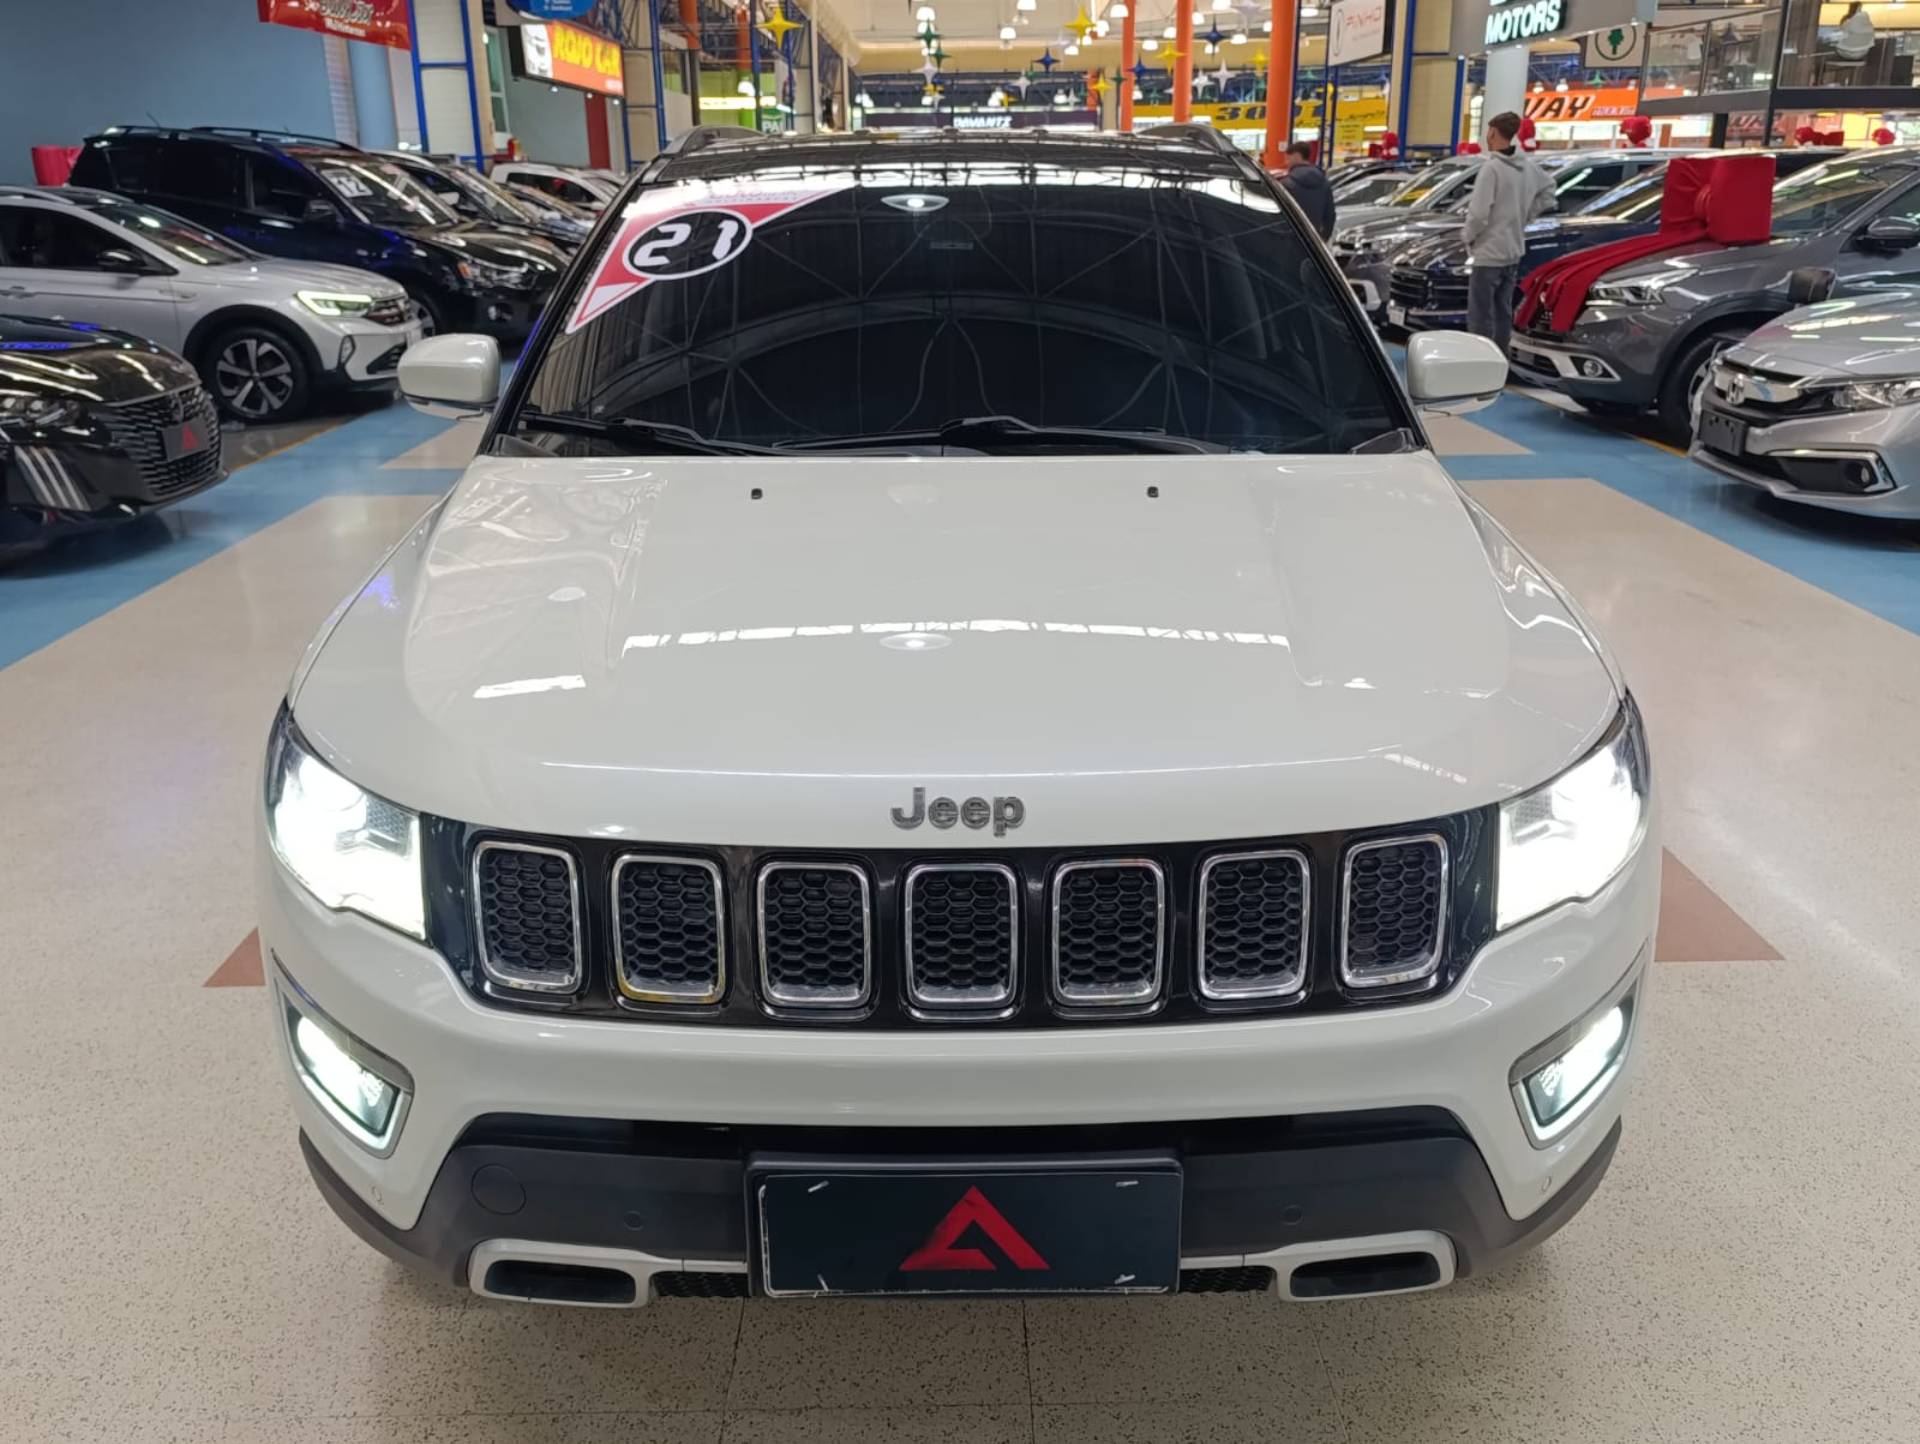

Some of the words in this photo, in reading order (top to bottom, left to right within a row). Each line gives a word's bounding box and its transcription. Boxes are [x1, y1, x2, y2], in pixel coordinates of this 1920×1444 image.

[1485, 0, 1561, 44] MOTORS
[633, 219, 739, 268] 21
[890, 786, 1024, 837] Jeep
